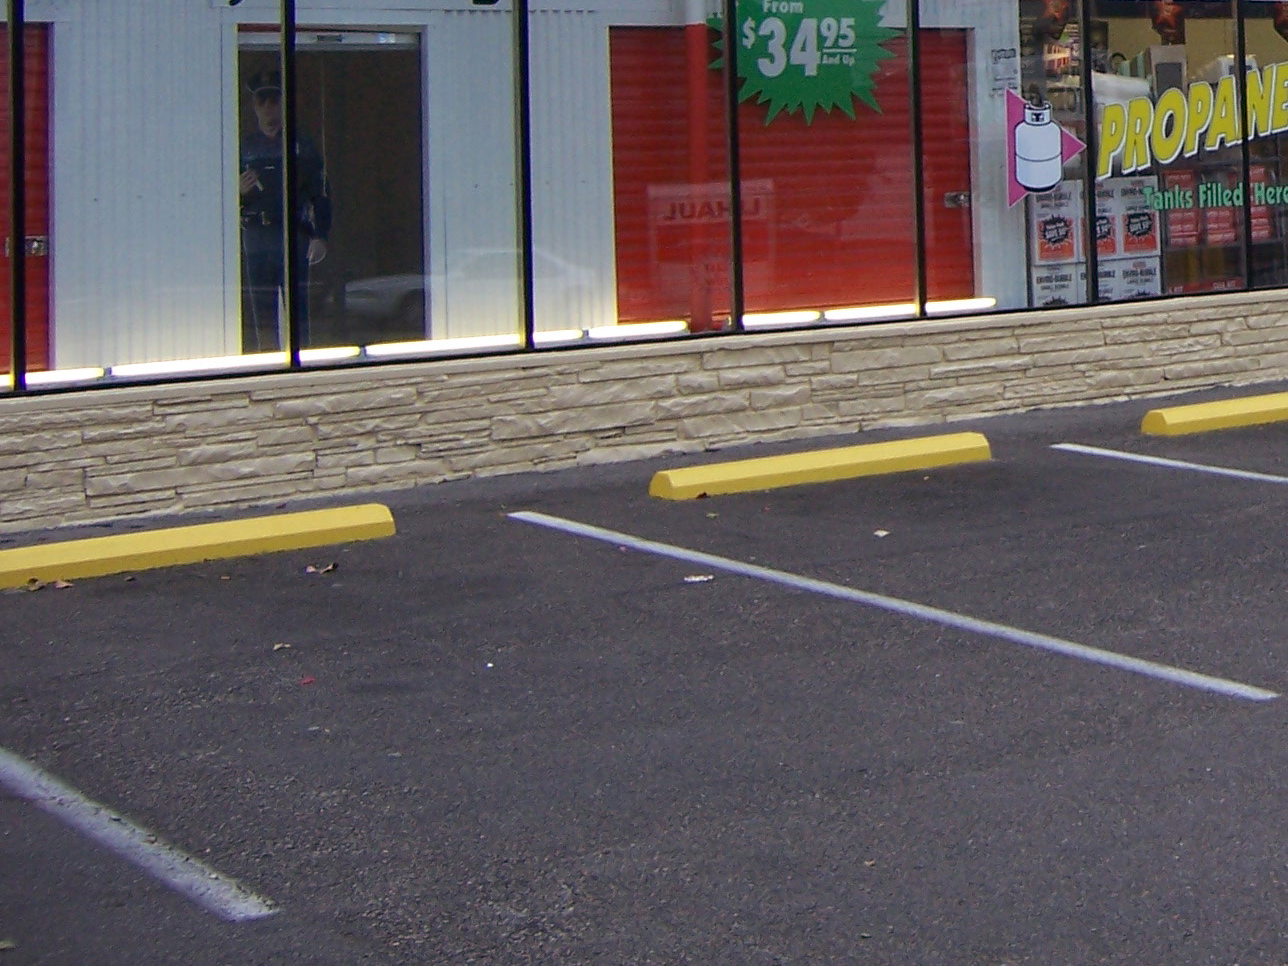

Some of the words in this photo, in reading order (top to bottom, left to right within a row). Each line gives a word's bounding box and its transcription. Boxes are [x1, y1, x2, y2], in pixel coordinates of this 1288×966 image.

[822, 54, 840, 65] And
[1143, 184, 1193, 210] Tanks
[1198, 182, 1244, 208] Filled
